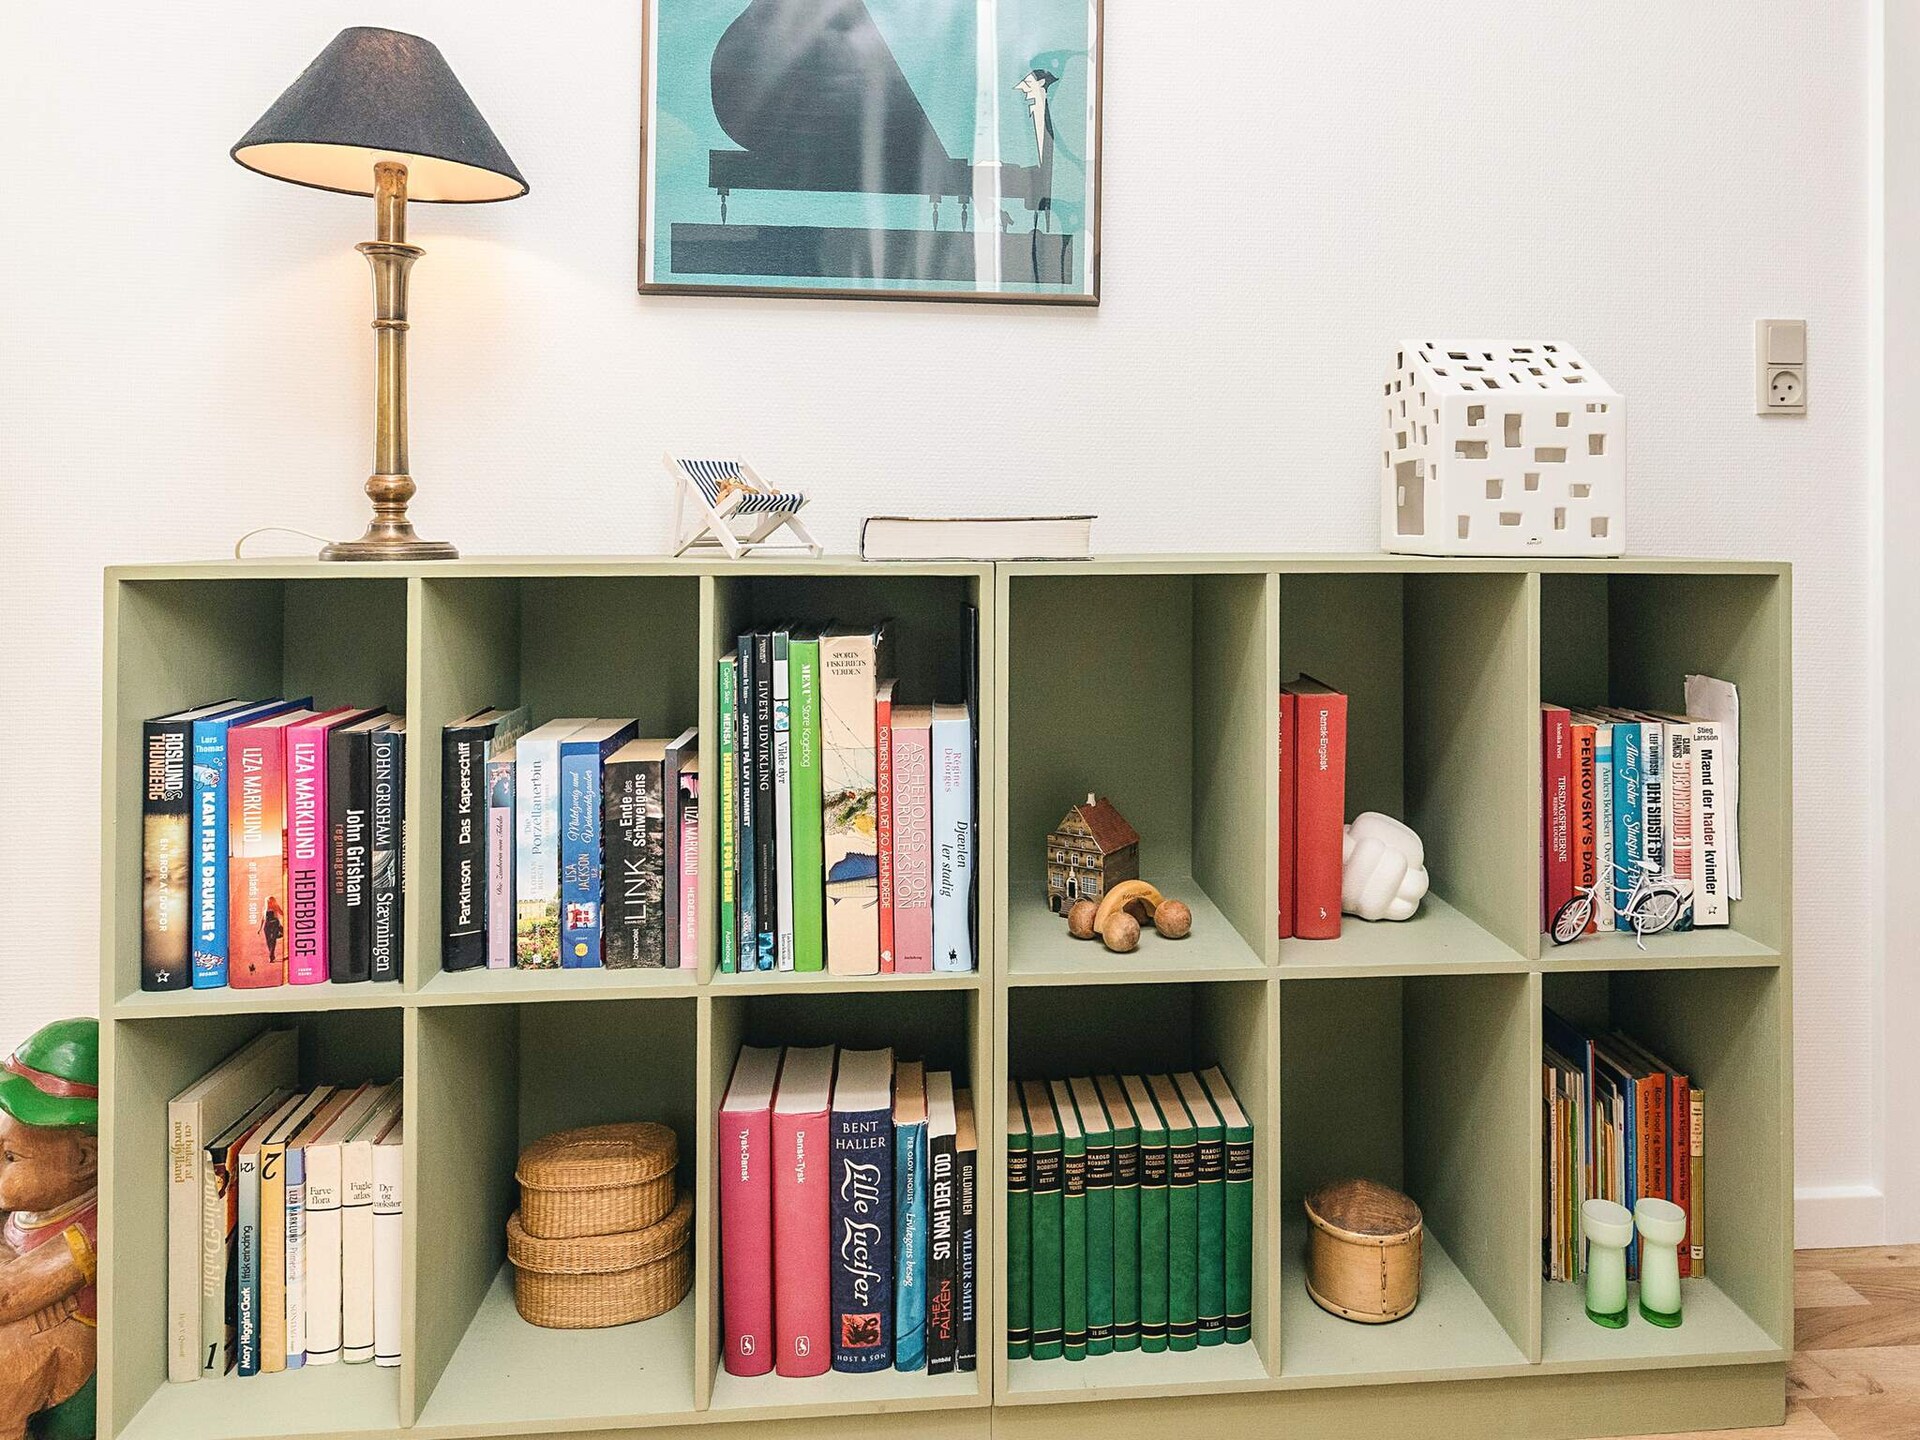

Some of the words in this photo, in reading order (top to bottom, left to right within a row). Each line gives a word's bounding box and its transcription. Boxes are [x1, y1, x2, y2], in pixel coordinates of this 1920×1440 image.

[723, 668, 731, 690] Carolyn
[758, 680, 768, 720] LIVETS
[802, 705, 811, 726] Store
[723, 712, 732, 745] MENSA
[742, 712, 750, 748] JAGTEN
[1319, 710, 1328, 771] Dansk-Engelsk
[1649, 734, 1658, 744] LEIF
[1694, 733, 1719, 741] Larsson
[1697, 727, 1714, 736] Stieg
[165, 734, 184, 790] ROSLUND
[196, 744, 224, 753] Thomas
[243, 747, 262, 772] LIZA
[296, 743, 315, 774] LIZA
[374, 742, 391, 780] JOHN
[743, 752, 752, 764] PÅ
[759, 725, 769, 791] UDVIKLING
[778, 741, 787, 766] Vilde
[800, 728, 811, 768] Kogebog
[880, 726, 888, 771] POLITIKENS
[1626, 734, 1640, 766] Alan
[1649, 746, 1658, 775] DAVIDSEN
[1672, 734, 1682, 758] FRANCIS
[1683, 738, 1691, 754] CLARE
[149, 734, 165, 800] THUNBERG
[459, 742, 471, 815] Kaperschiff
[569, 772, 578, 786] und
[776, 768, 787, 783] dyr
[944, 748, 952, 792] Deforges
[1602, 767, 1611, 797] Anders
[1700, 749, 1712, 786] Mænd
[724, 752, 732, 843] HJERNEVRIDERE
[880, 774, 889, 793] BOG
[912, 742, 926, 852] ASCHEHOUGS
[1581, 738, 1594, 844] PENKOVSKY'S
[1620, 767, 1640, 807] Fisher
[1647, 783, 1661, 803] DEN
[1702, 790, 1713, 809] der
[202, 792, 216, 826] KAN
[242, 775, 262, 842] MARKLUND
[376, 783, 391, 846] GRISHAM
[532, 760, 542, 855] Porzellanerbin
[567, 791, 580, 841] Mistelzweig
[581, 770, 593, 844] Weihnachtszauber
[620, 796, 632, 827] Ende
[633, 774, 646, 848] Schweigens
[684, 806, 698, 825] LIZA
[880, 794, 889, 810] OM
[296, 778, 316, 860] MARKLUND
[347, 809, 364, 842] John
[459, 818, 471, 844] Das
[496, 815, 504, 838] Toledo
[880, 812, 890, 829] DET
[896, 744, 912, 910] KRYDSORDSLEKSIKON
[1558, 776, 1566, 863] TIRSDAGSFRUERNE
[1602, 800, 1611, 837] Bodelsen
[1648, 807, 1662, 846] SIDSTE
[1702, 813, 1714, 847] hader
[160, 838, 168, 850] EN
[202, 829, 216, 863] FISK
[624, 829, 632, 841] Am
[880, 832, 890, 848] 20.
[954, 821, 968, 867] Djævlen
[1624, 815, 1640, 857] Slutspil
[160, 854, 168, 879] BROR
[333, 823, 344, 894] regnmageren
[496, 852, 504, 880] Zauberin
[684, 828, 698, 876] MARKLUND
[724, 846, 732, 868] FOR
[942, 844, 953, 861] ler
[1673, 849, 1692, 880] RØDT
[160, 882, 168, 894] AT
[347, 846, 364, 907] Grisham
[566, 864, 576, 883] LISA
[578, 853, 590, 891] JACKSON
[724, 870, 732, 902] BØRN
[881, 850, 891, 908] ÅRHUNDREDE
[912, 860, 926, 908] STORE
[939, 863, 954, 897] stadig
[1704, 850, 1716, 896] kvinder
[202, 866, 216, 931] DRUKNE
[459, 860, 471, 925] Parkinson
[496, 882, 504, 895] Die
[625, 858, 646, 923] LINK
[159, 913, 167, 932] FOR
[248, 904, 258, 925] solen
[295, 870, 316, 956] HEDEBØLGE
[373, 892, 394, 972] Stævningen
[724, 931, 732, 964] Aschehoug
[843, 1121, 878, 1133] BENT
[1653, 1135, 1660, 1144] og
[1678, 1120, 1686, 1146] Kipling
[171, 1121, 184, 1183] nordjylland
[738, 1129, 750, 1182] Tysk-Dansk
[796, 1131, 805, 1184] Dansk-Tysk
[836, 1138, 886, 1150] HALLER
[1654, 1147, 1662, 1165] hans
[185, 1170, 194, 1181] af
[240, 1162, 255, 1173] 121
[262, 1152, 283, 1180] 2
[934, 1153, 950, 1181] TOD
[1654, 1168, 1662, 1191] Mænd
[289, 1190, 298, 1204] LIZA
[312, 1196, 330, 1204] flora
[353, 1192, 370, 1200] atlas
[379, 1184, 394, 1193] Dyr
[841, 1158, 881, 1214] Lille
[934, 1181, 950, 1209] DER
[962, 1166, 972, 1215] GULDMINEN
[289, 1206, 298, 1243] MARKLUND
[903, 1213, 915, 1258] Livlægens
[934, 1211, 950, 1239] NAH
[242, 1225, 253, 1262] erindring
[933, 1242, 950, 1261] SO
[963, 1228, 972, 1279] WILBUR
[242, 1263, 250, 1279] frisk
[841, 1218, 881, 1306] Lucifer
[903, 1261, 914, 1286] besøg
[241, 1287, 251, 1311] Clark
[932, 1294, 940, 1327] THEA
[940, 1280, 951, 1340] FALKEN
[963, 1281, 972, 1321] SMITH
[241, 1312, 252, 1344] Higgins
[204, 1342, 217, 1370] 1
[241, 1346, 252, 1369] Mary
[837, 1355, 858, 1363] HØST
[869, 1353, 886, 1361] SØN
